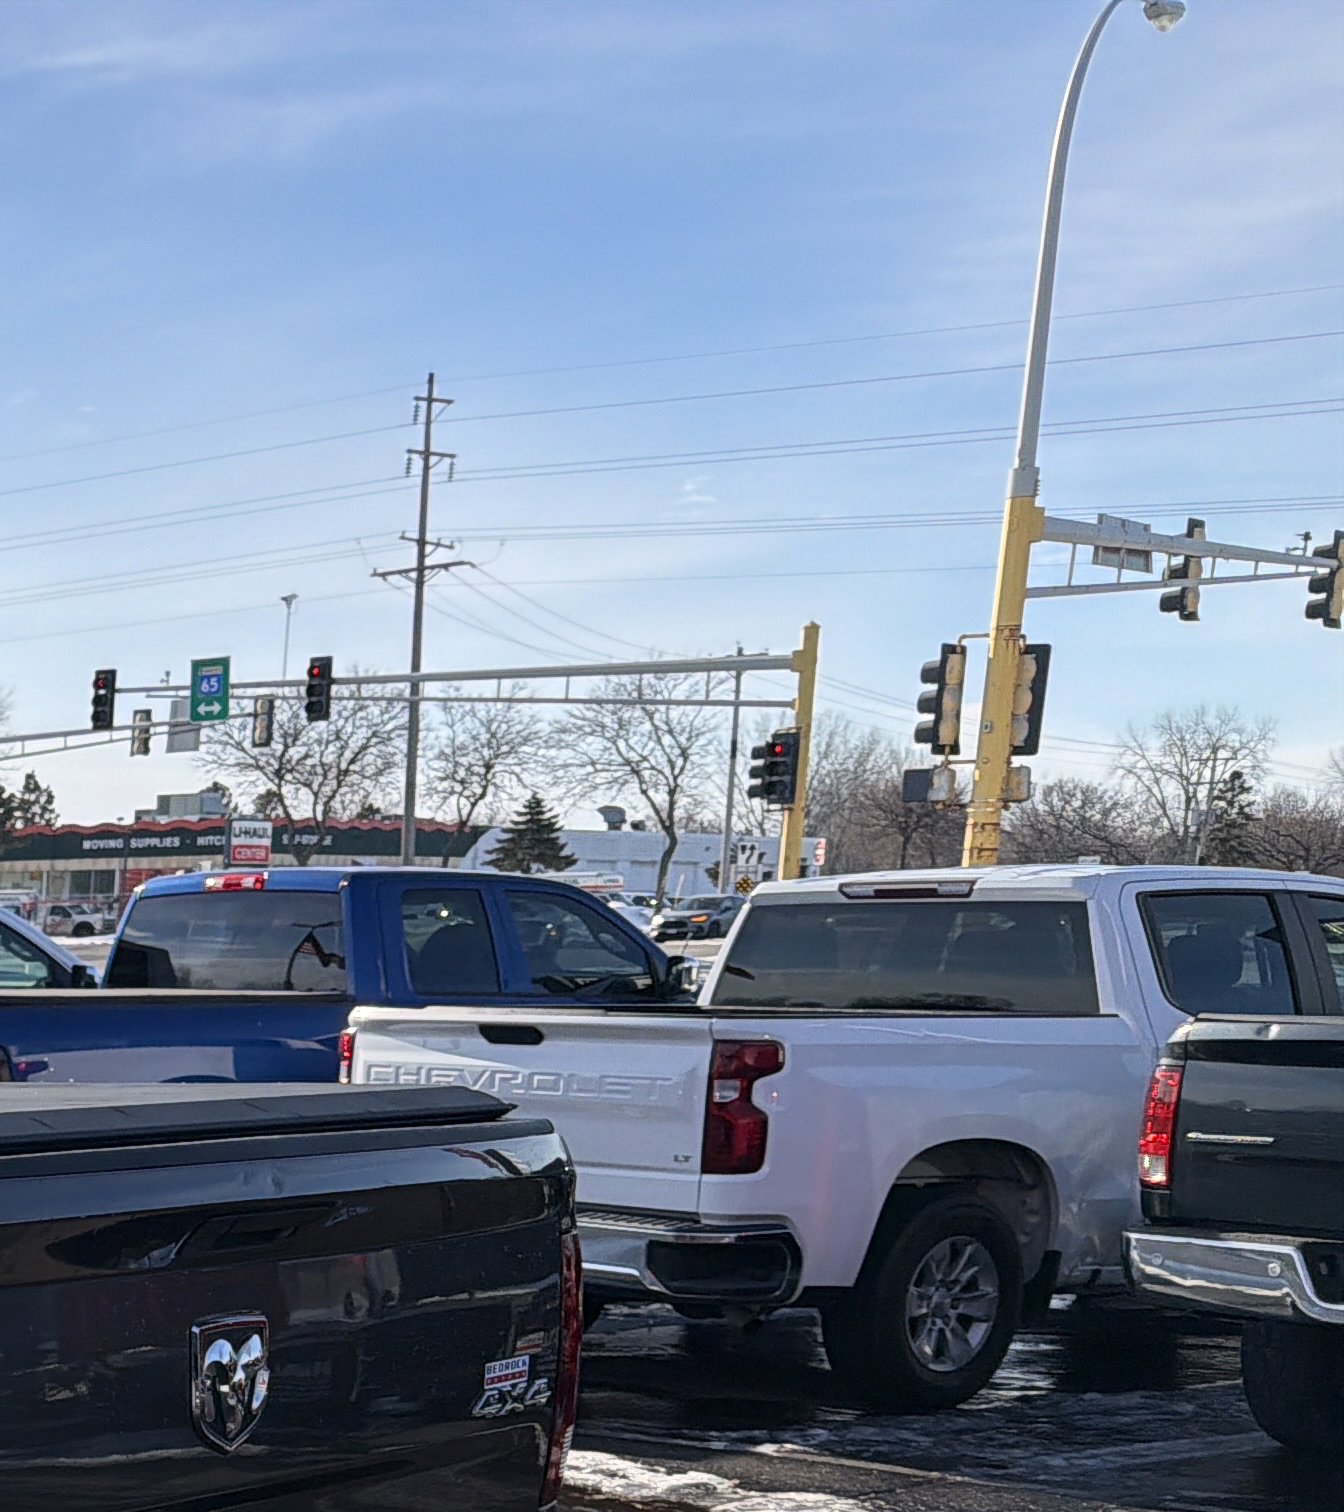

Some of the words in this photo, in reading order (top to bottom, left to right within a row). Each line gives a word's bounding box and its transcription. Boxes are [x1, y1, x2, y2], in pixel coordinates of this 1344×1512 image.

[200, 677, 219, 693] 65
[232, 826, 271, 839] U-HAUL
[82, 838, 124, 850] MOVING
[129, 836, 181, 848] SUPPLIES
[367, 1063, 674, 1100] CHEVROLET
[673, 1154, 692, 1163] LT
[486, 1357, 528, 1376] BEDROCK
